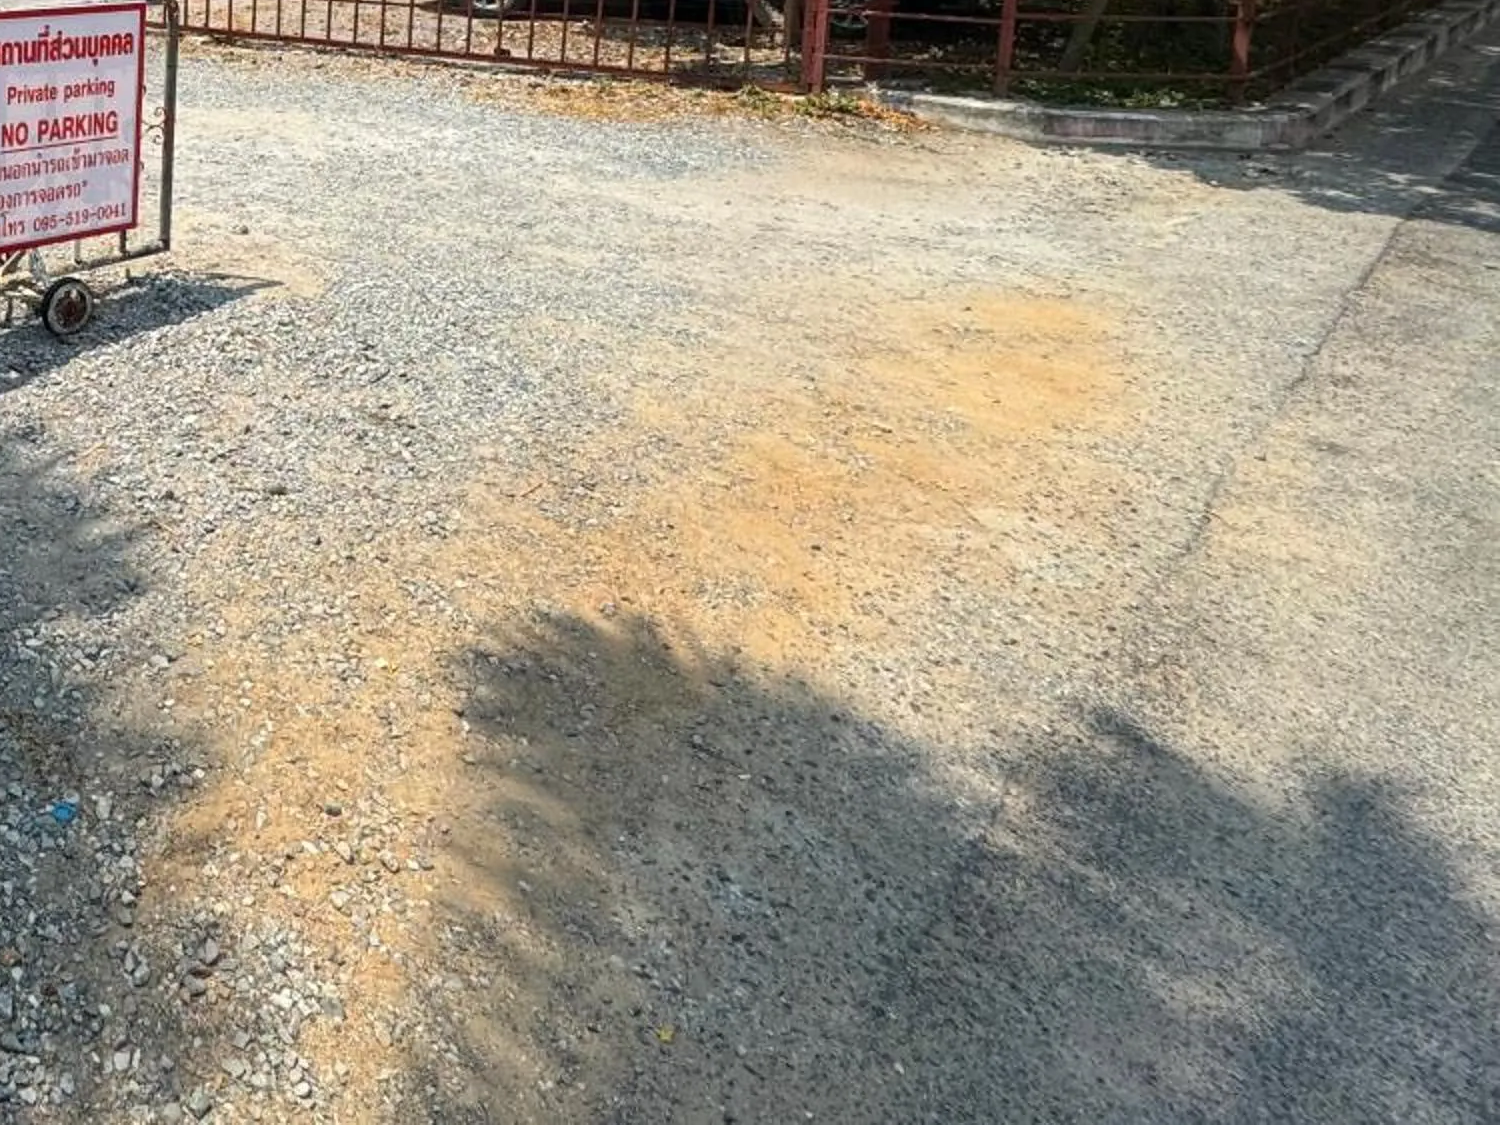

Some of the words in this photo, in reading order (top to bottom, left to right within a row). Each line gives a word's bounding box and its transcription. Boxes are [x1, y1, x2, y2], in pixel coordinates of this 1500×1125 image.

[6, 83, 58, 105] Private
[63, 78, 115, 102] parking
[1, 121, 28, 148] NO
[37, 111, 119, 143] PARKING
